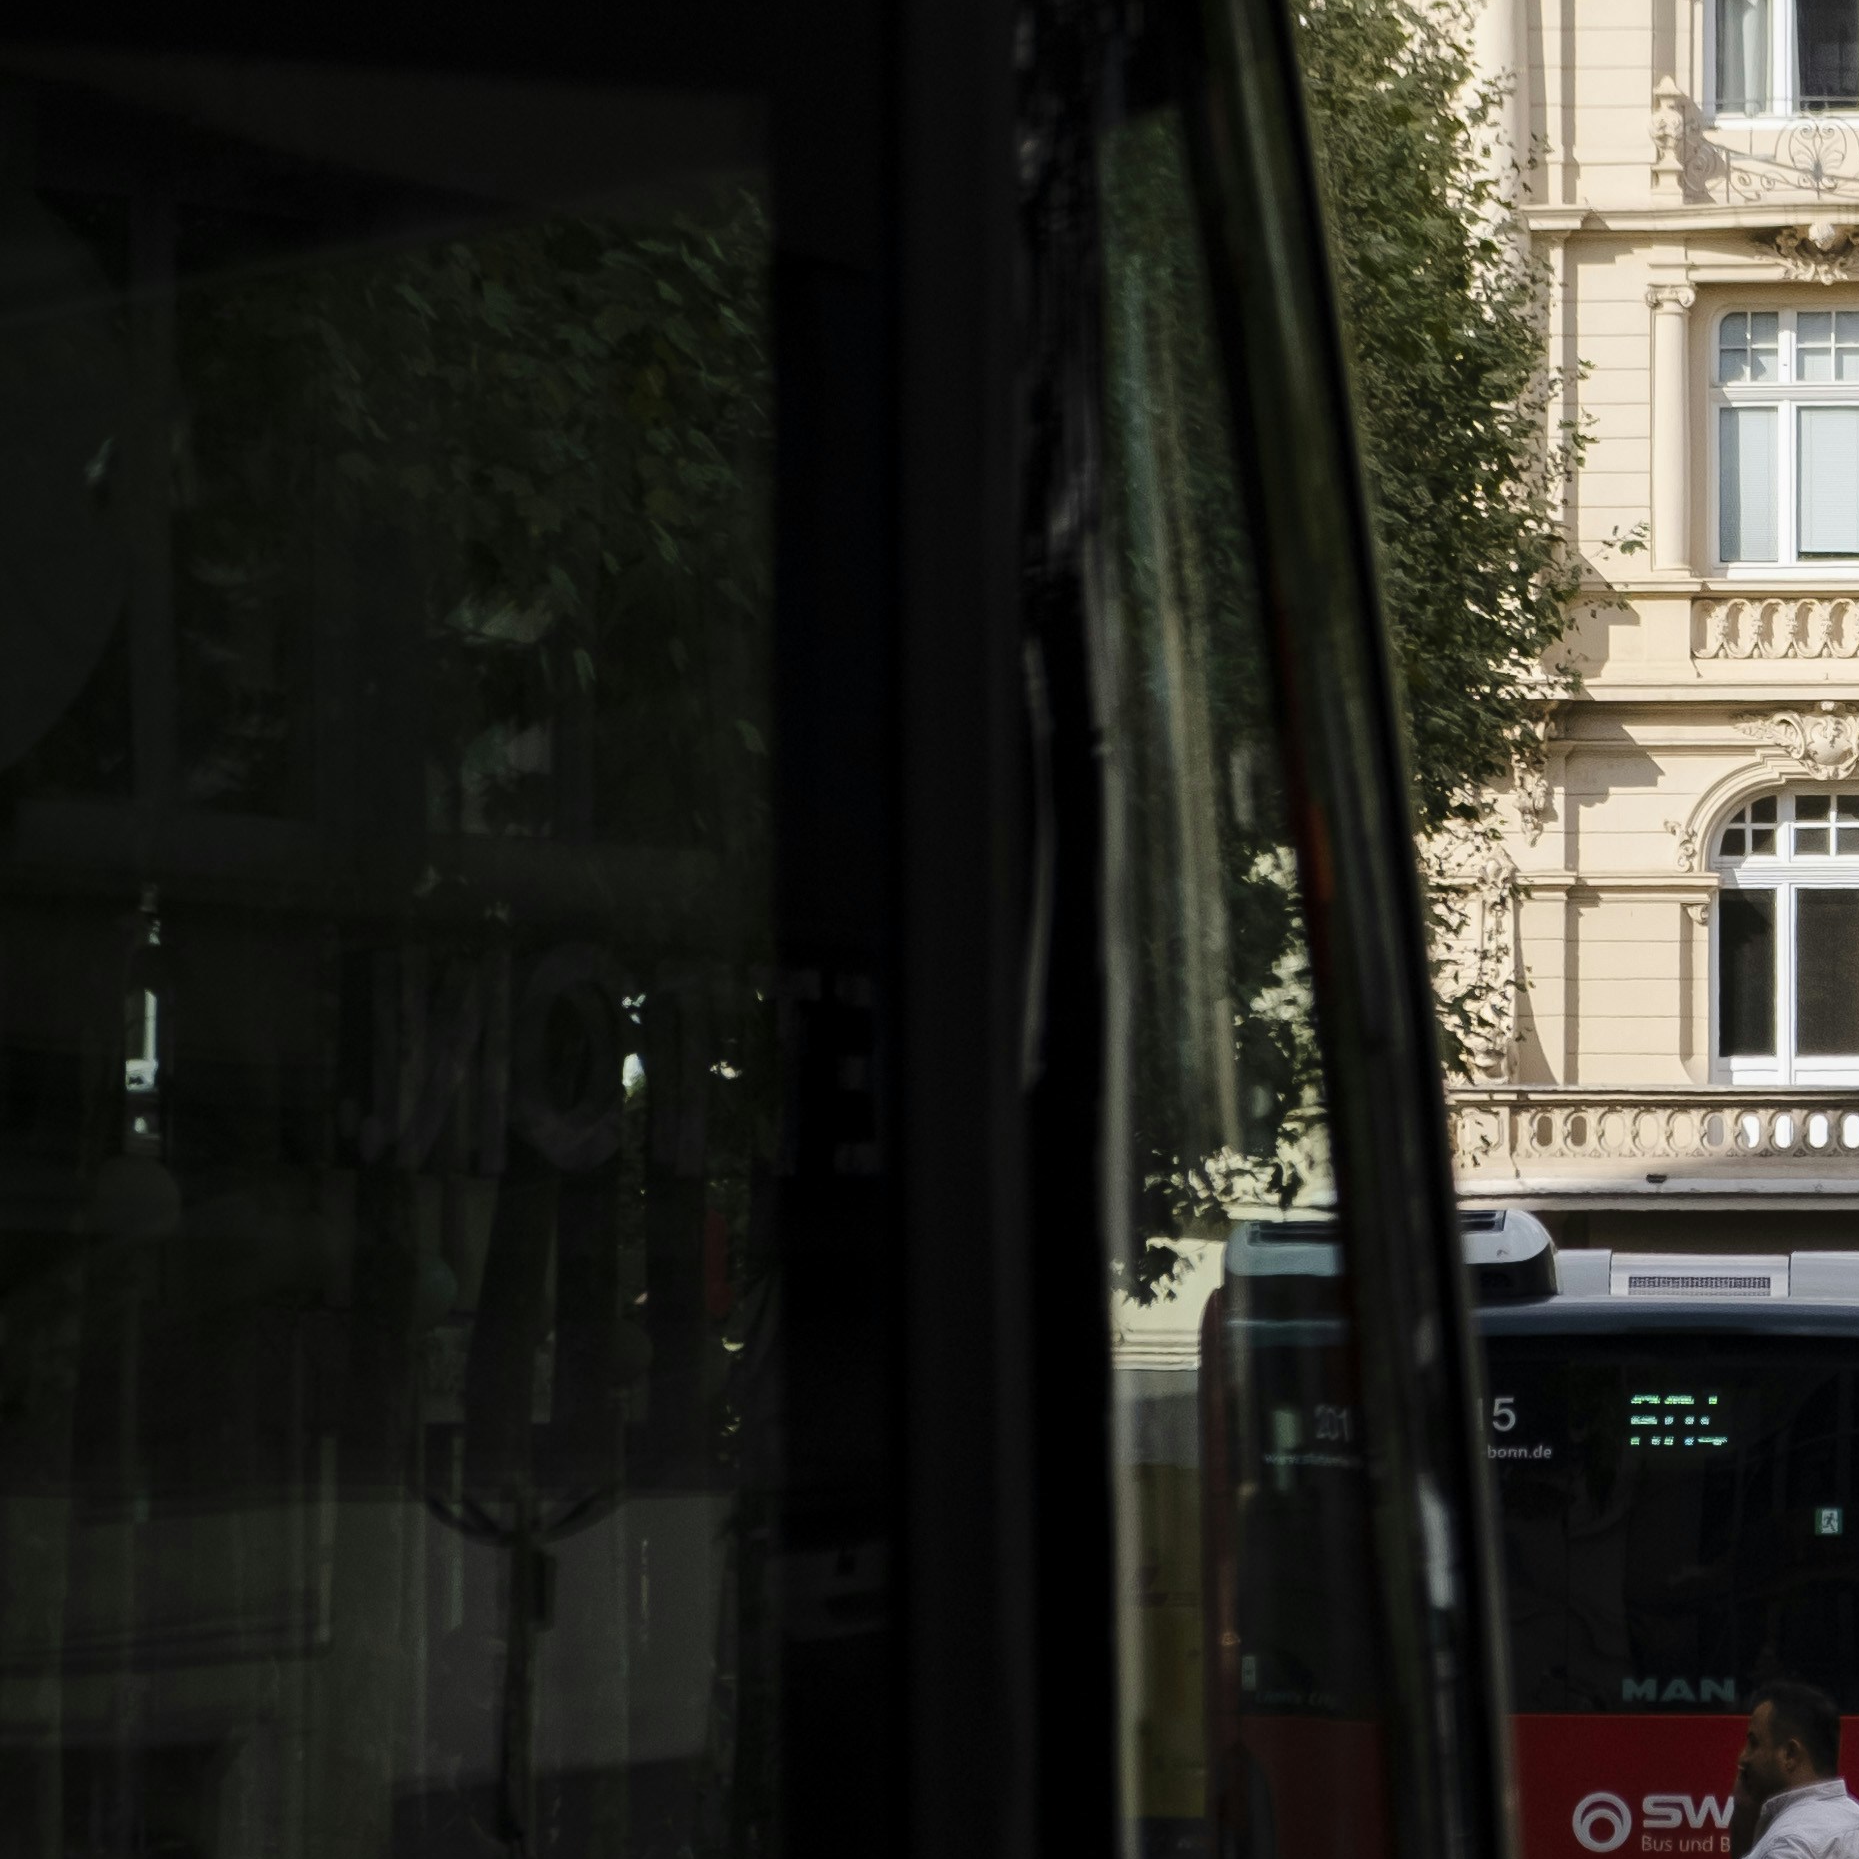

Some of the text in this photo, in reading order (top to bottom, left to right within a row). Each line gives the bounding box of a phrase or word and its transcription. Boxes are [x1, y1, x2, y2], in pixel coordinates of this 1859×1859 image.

[1622, 1677, 1736, 1703] MAN
[1642, 1795, 1734, 1829] SW
[1641, 1834, 1731, 1852] Bus und B
